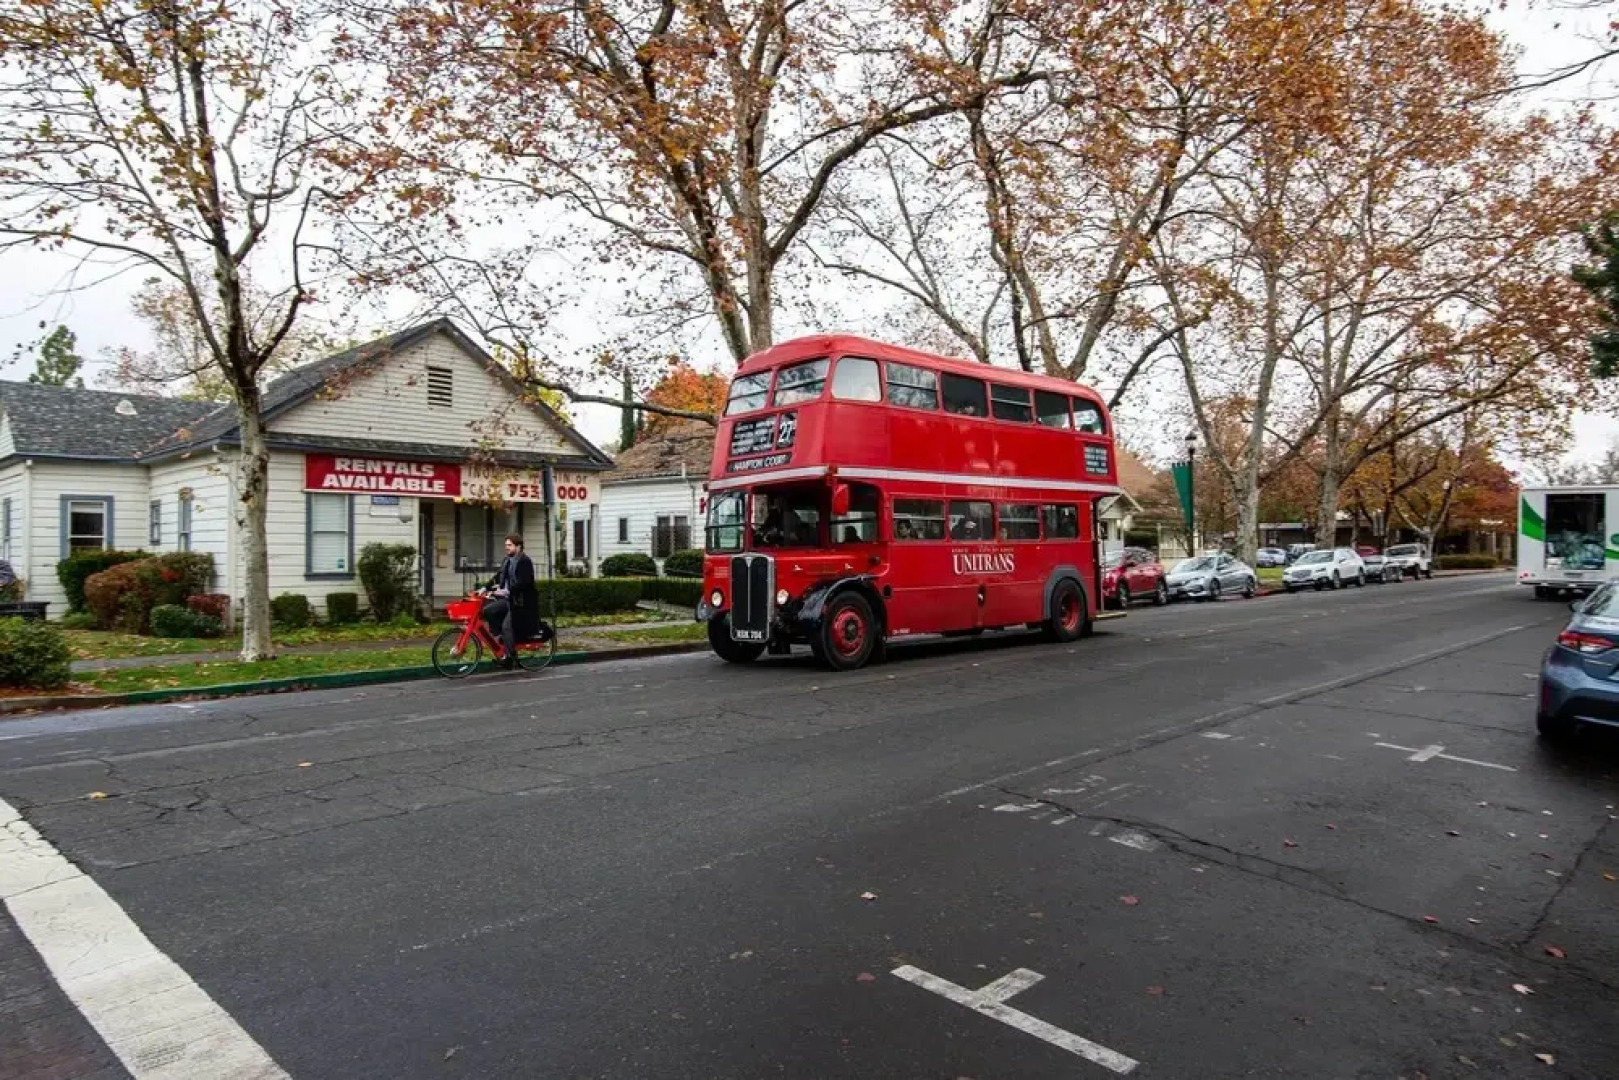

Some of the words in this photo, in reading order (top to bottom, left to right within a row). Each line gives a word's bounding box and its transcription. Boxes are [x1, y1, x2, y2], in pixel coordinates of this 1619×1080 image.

[335, 458, 435, 477] RENTALS
[322, 473, 446, 493] AVAILABLE
[952, 553, 1015, 576] UNITRANS
